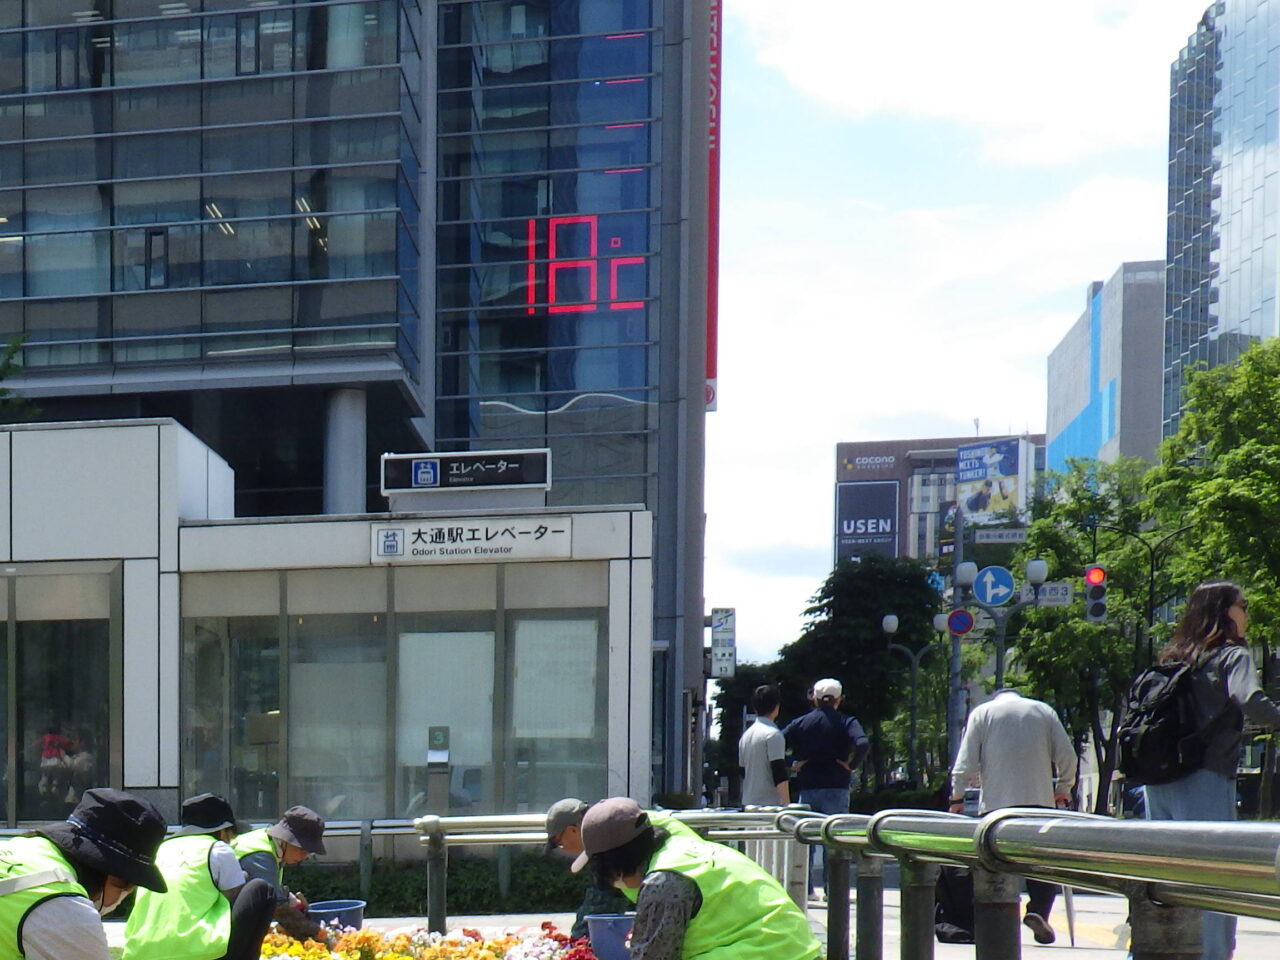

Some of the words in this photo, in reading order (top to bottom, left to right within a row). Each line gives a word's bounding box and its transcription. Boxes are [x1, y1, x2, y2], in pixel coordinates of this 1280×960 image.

[449, 459, 519, 474] エレベーター
[843, 518, 892, 534] USEN
[411, 524, 565, 545] 大通駅エレベーター
[412, 547, 436, 556] Odori
[439, 547, 471, 555] Station
[474, 546, 513, 554] Elevator
